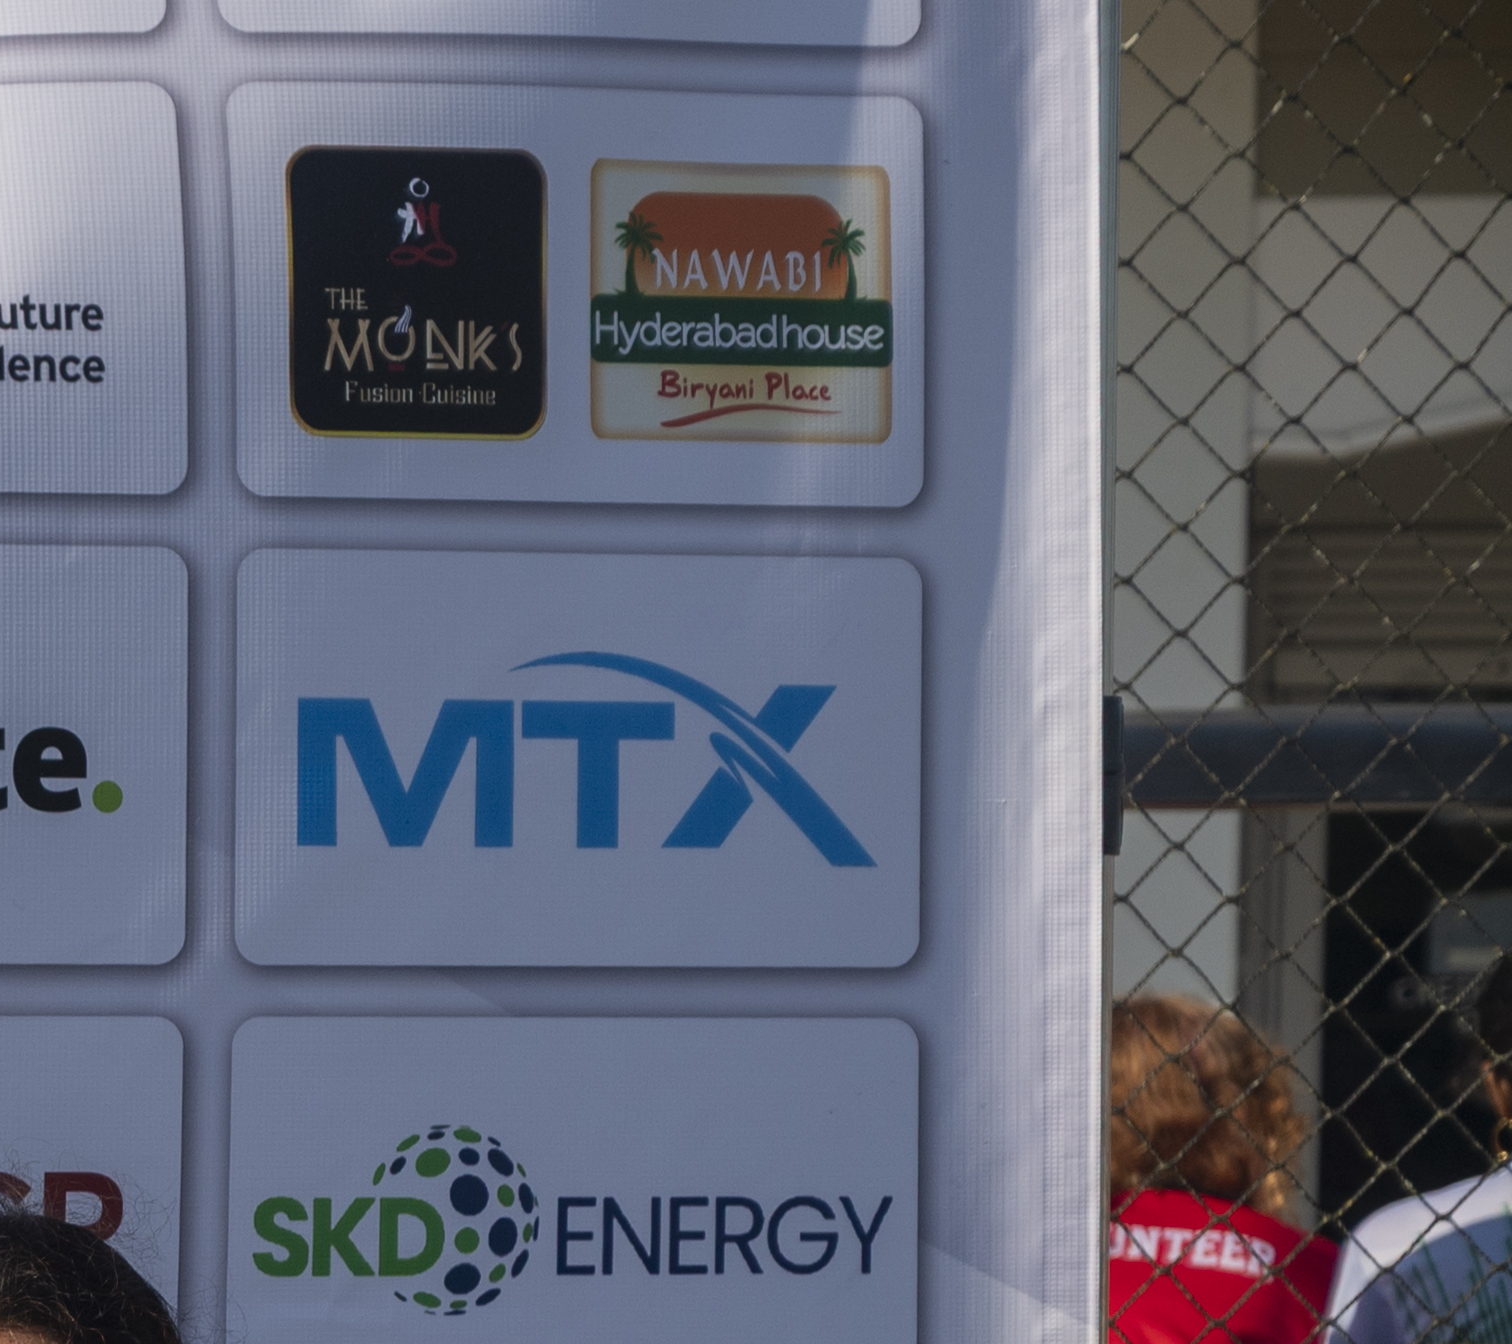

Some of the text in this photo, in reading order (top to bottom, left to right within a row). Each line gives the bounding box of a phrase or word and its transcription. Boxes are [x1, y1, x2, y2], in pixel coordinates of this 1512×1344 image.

[652, 248, 822, 293] NAWABI
[324, 287, 369, 310] THE
[345, 380, 496, 405] Fusion Cuisine
[658, 369, 832, 408] Biryani Place
[297, 651, 878, 867] MTX
[252, 1195, 894, 1278] SKD ENERGY
